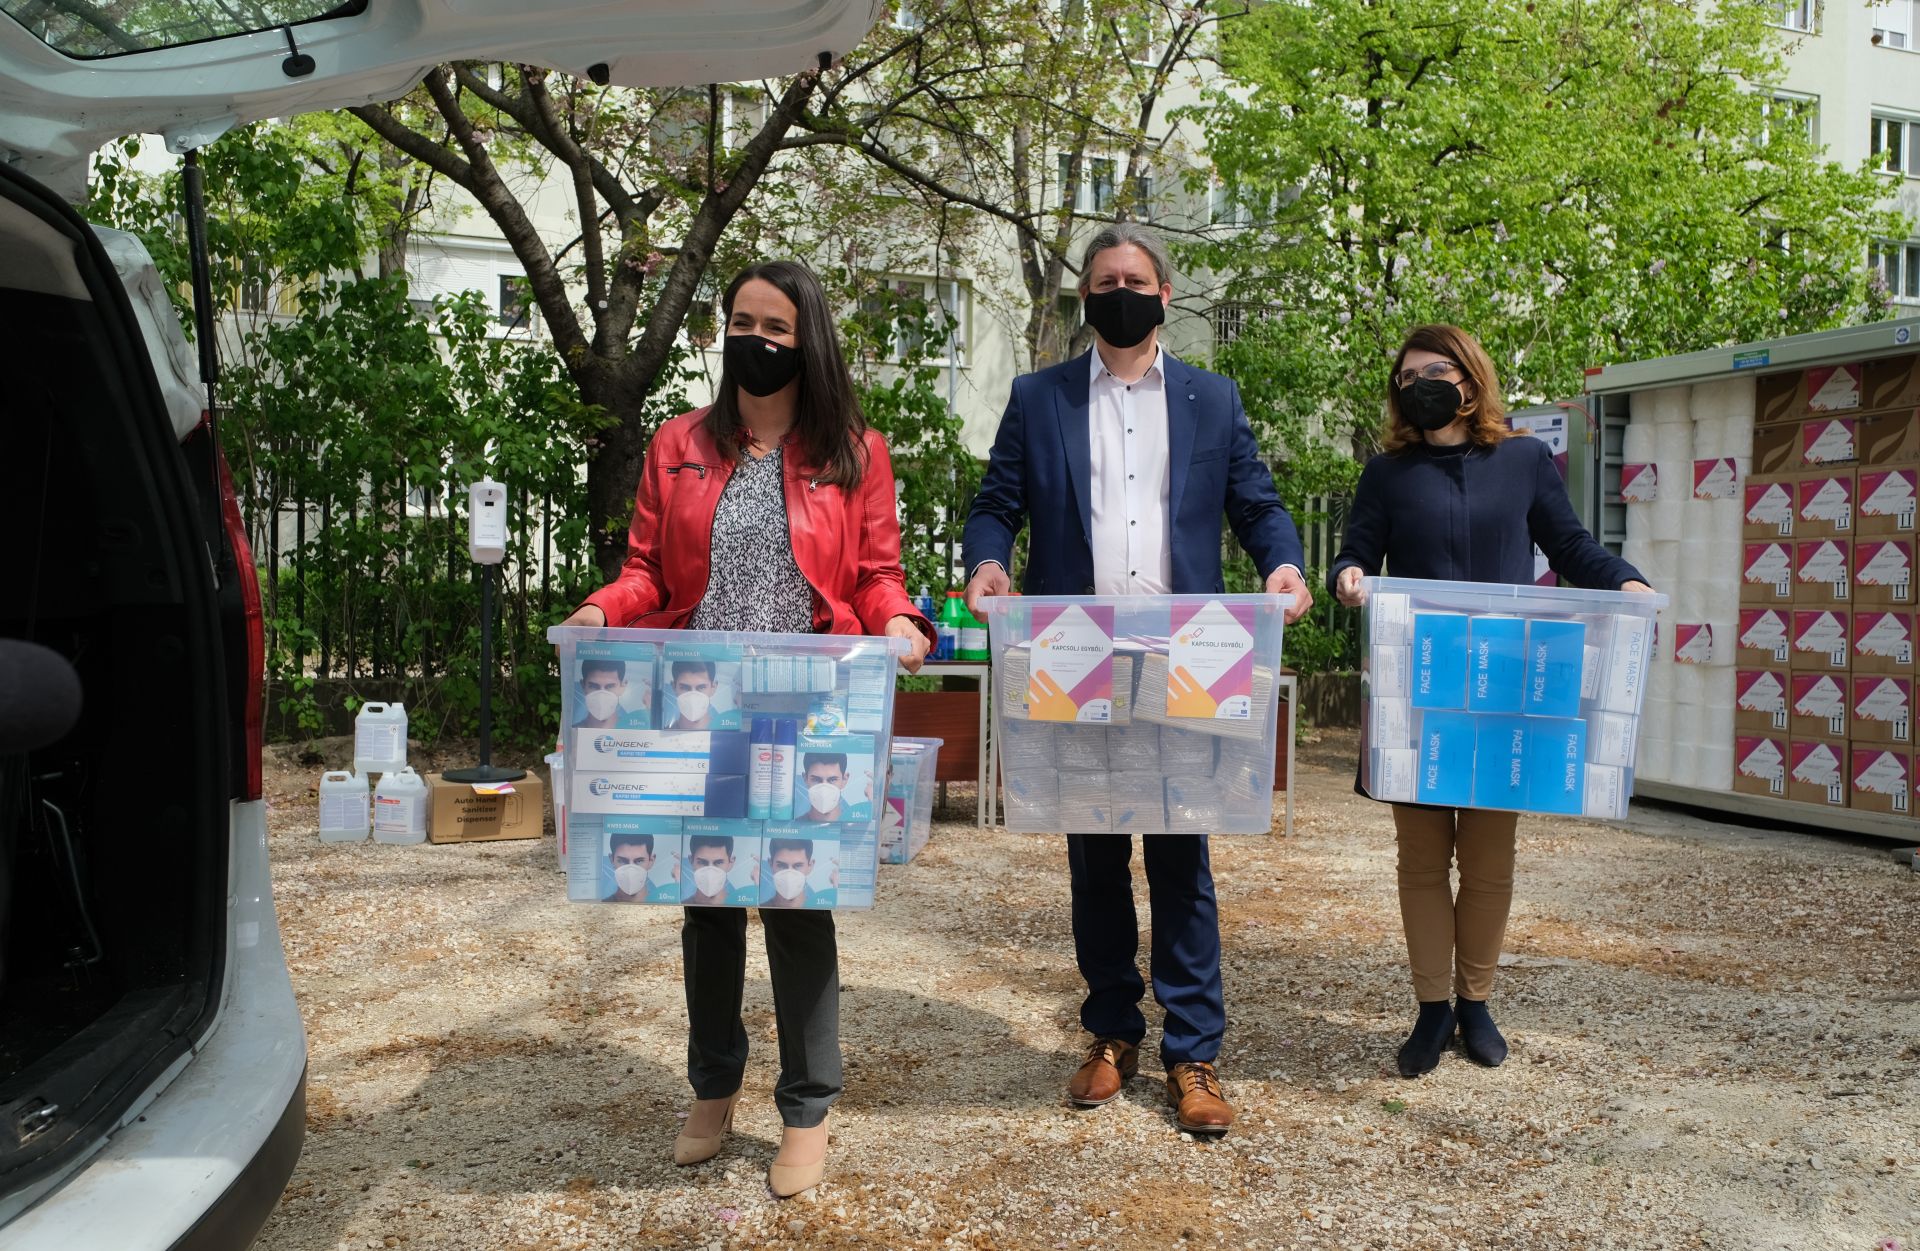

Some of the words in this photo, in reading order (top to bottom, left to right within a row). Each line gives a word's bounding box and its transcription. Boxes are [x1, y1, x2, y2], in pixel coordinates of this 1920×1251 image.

[1191, 640, 1220, 648] KAPCSOLJ
[1422, 637, 1432, 665] MASK
[1479, 641, 1489, 669] MASK
[1630, 631, 1641, 657] FACE
[1536, 644, 1548, 673] MASK
[1421, 668, 1431, 694] FACE
[1477, 673, 1488, 698] FACE
[1626, 660, 1637, 688] MASK
[1533, 676, 1545, 702] FACE
[1430, 733, 1440, 760] MASK
[1512, 729, 1523, 755] FACE
[1567, 733, 1577, 759] FACE
[1427, 764, 1438, 789] FACE
[1510, 758, 1521, 787] MASK
[1564, 763, 1576, 791] MASK
